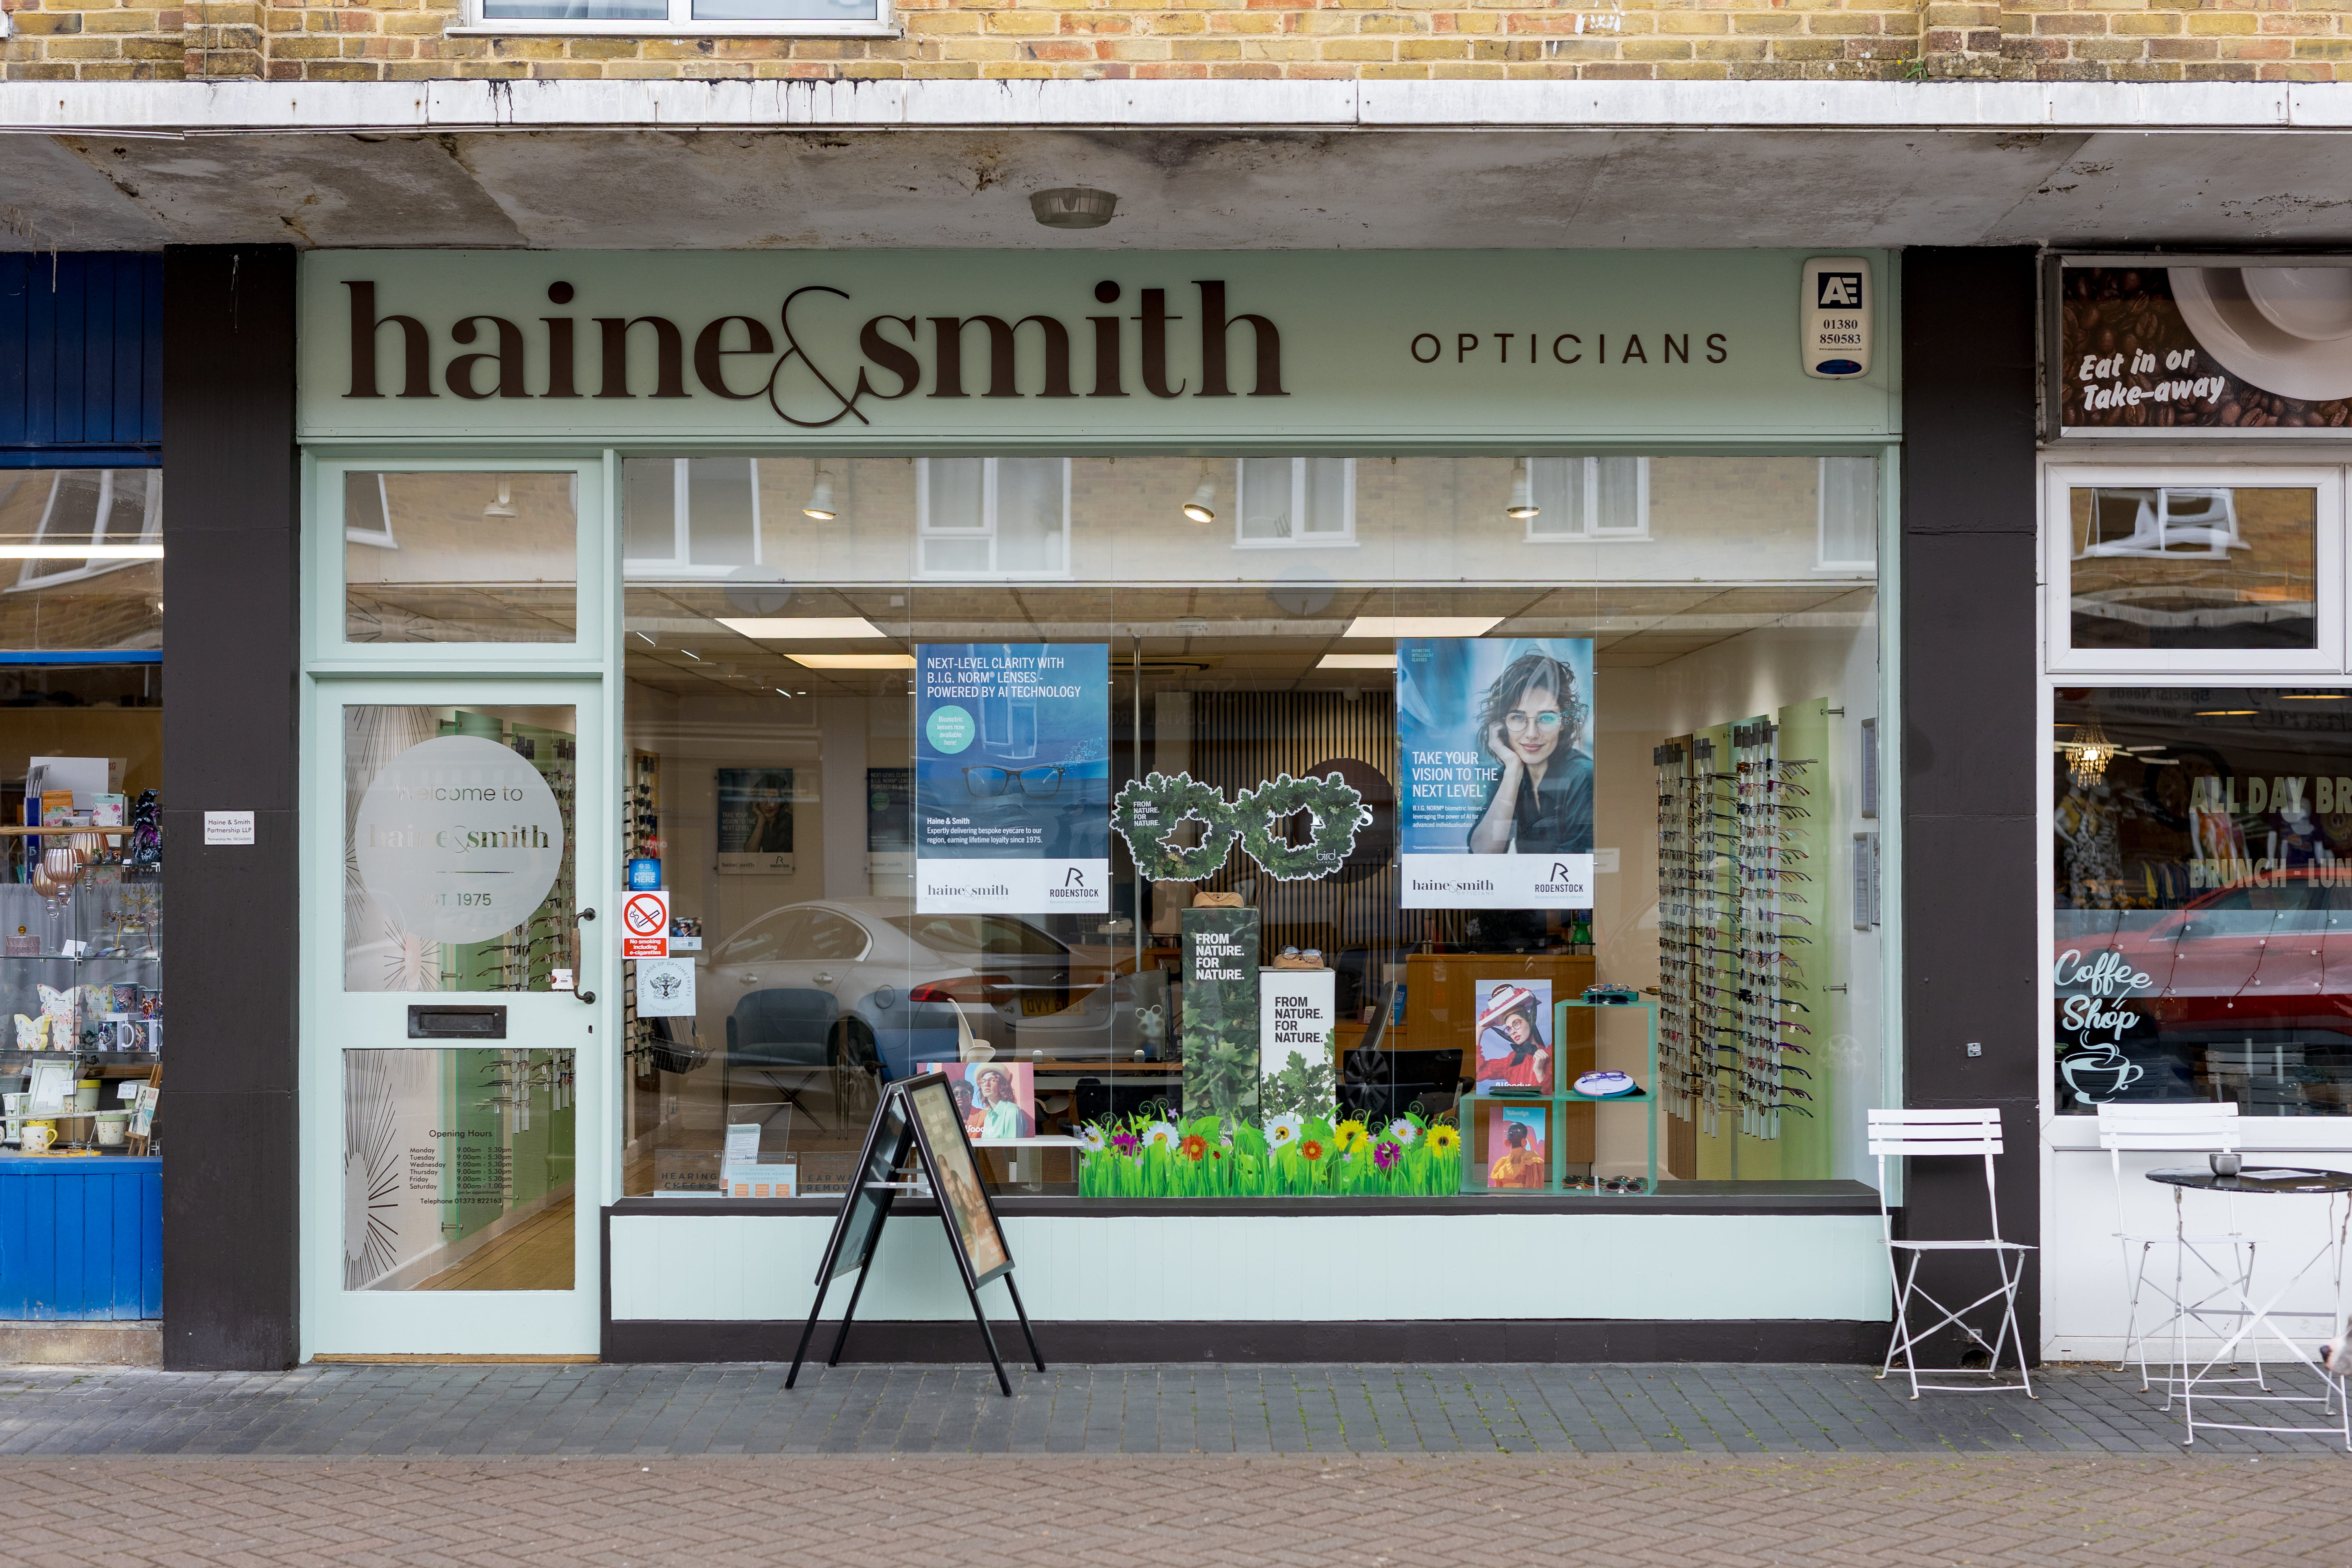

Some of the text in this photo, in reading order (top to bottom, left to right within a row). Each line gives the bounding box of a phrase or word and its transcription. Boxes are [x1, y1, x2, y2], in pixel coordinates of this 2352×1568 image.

[1824, 319, 1857, 329] 01380
[1820, 334, 1860, 343] 850583
[1412, 333, 1727, 364] OPTICIANS
[2079, 348, 2195, 381] Eat in or
[2083, 376, 2225, 411] Take-away
[928, 657, 1063, 669] NEXT-LEVEL CLARITY WITH
[928, 672, 954, 683] B.I.G.
[998, 672, 1036, 682] LENSES
[928, 686, 1081, 697] POWERED BY AI TECHNOLOGY
[1412, 752, 1478, 764] TAKE YOUR
[1412, 768, 1498, 780] VISION TO THE
[502, 786, 523, 801] to
[1413, 784, 1444, 797] NEXT
[2190, 777, 2240, 813] ALL
[2248, 777, 2307, 813] DAY
[1003, 827, 1024, 835] eyecare
[1316, 849, 1336, 861] bird
[2190, 859, 2287, 888] BRUNCH
[457, 894, 491, 906] 1975
[1196, 934, 1229, 944] FROM
[1196, 945, 1244, 956] NATURE.
[1196, 958, 1219, 968] FOR
[1197, 969, 1244, 979] NATURE.
[2054, 949, 2153, 996] Coffee
[641, 964, 656, 986] COLLEGE
[667, 962, 691, 997] OPTOMETRISTS
[1275, 997, 1307, 1007] FROM
[649, 1003, 670, 1013] MEMBER
[1275, 1009, 1323, 1019] NATURE.
[2062, 994, 2140, 1040] Shop
[1275, 1021, 1297, 1031] FOR
[1275, 1033, 1323, 1042] NATURE.
[429, 1130, 465, 1138] Opening
